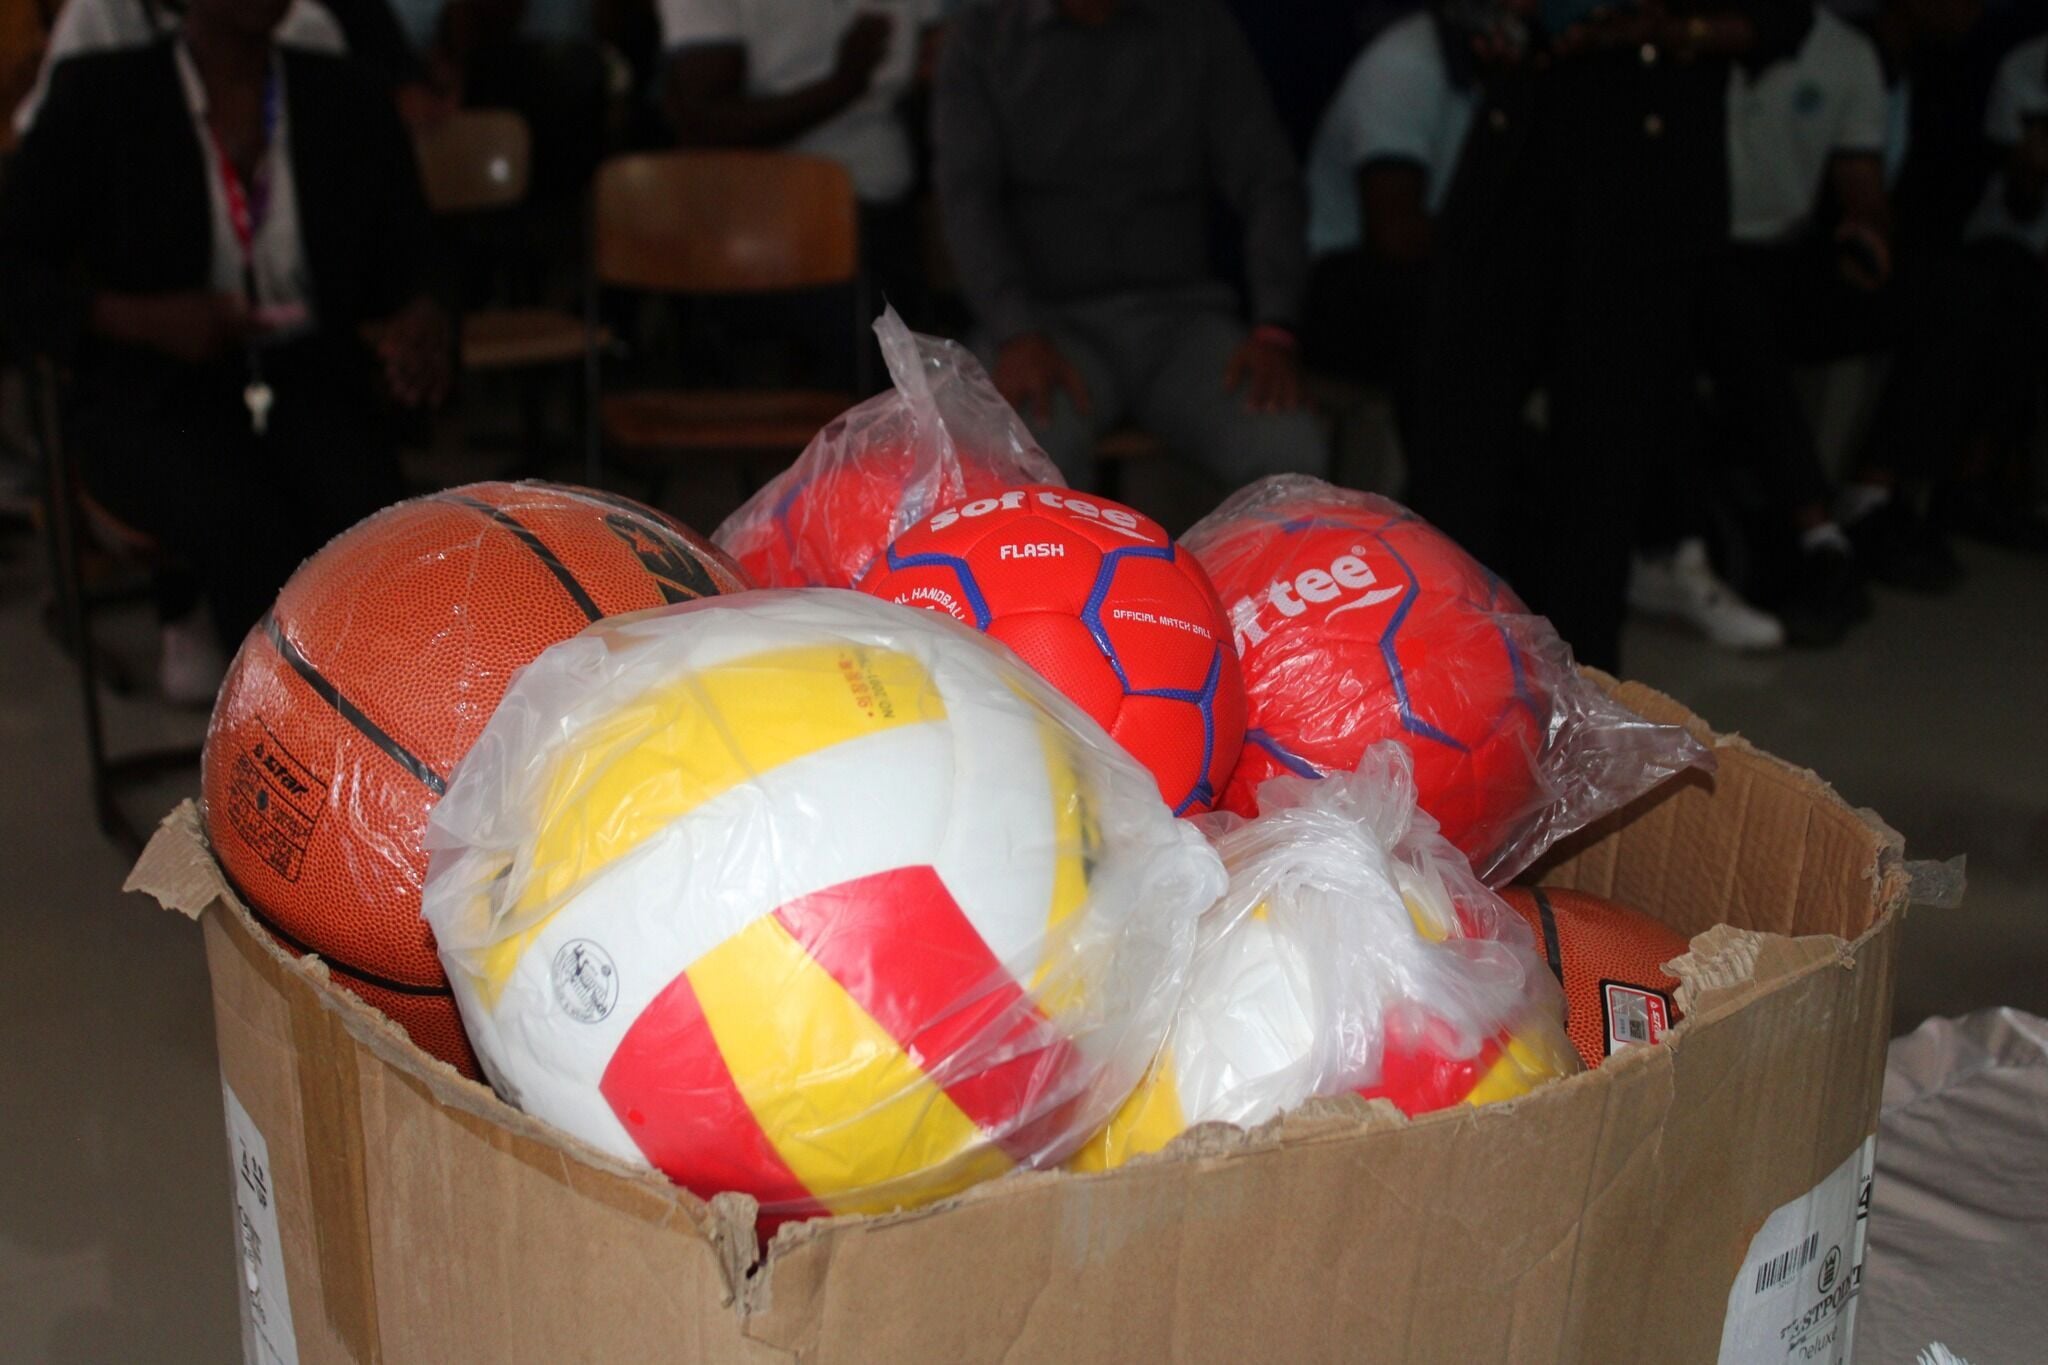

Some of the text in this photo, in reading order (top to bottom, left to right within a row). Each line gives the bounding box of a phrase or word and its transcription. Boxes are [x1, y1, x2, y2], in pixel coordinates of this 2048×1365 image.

[1000, 542, 1065, 560] FLASH
[1113, 609, 1157, 623] OFFICIAL
[1159, 615, 1191, 631] MATCH
